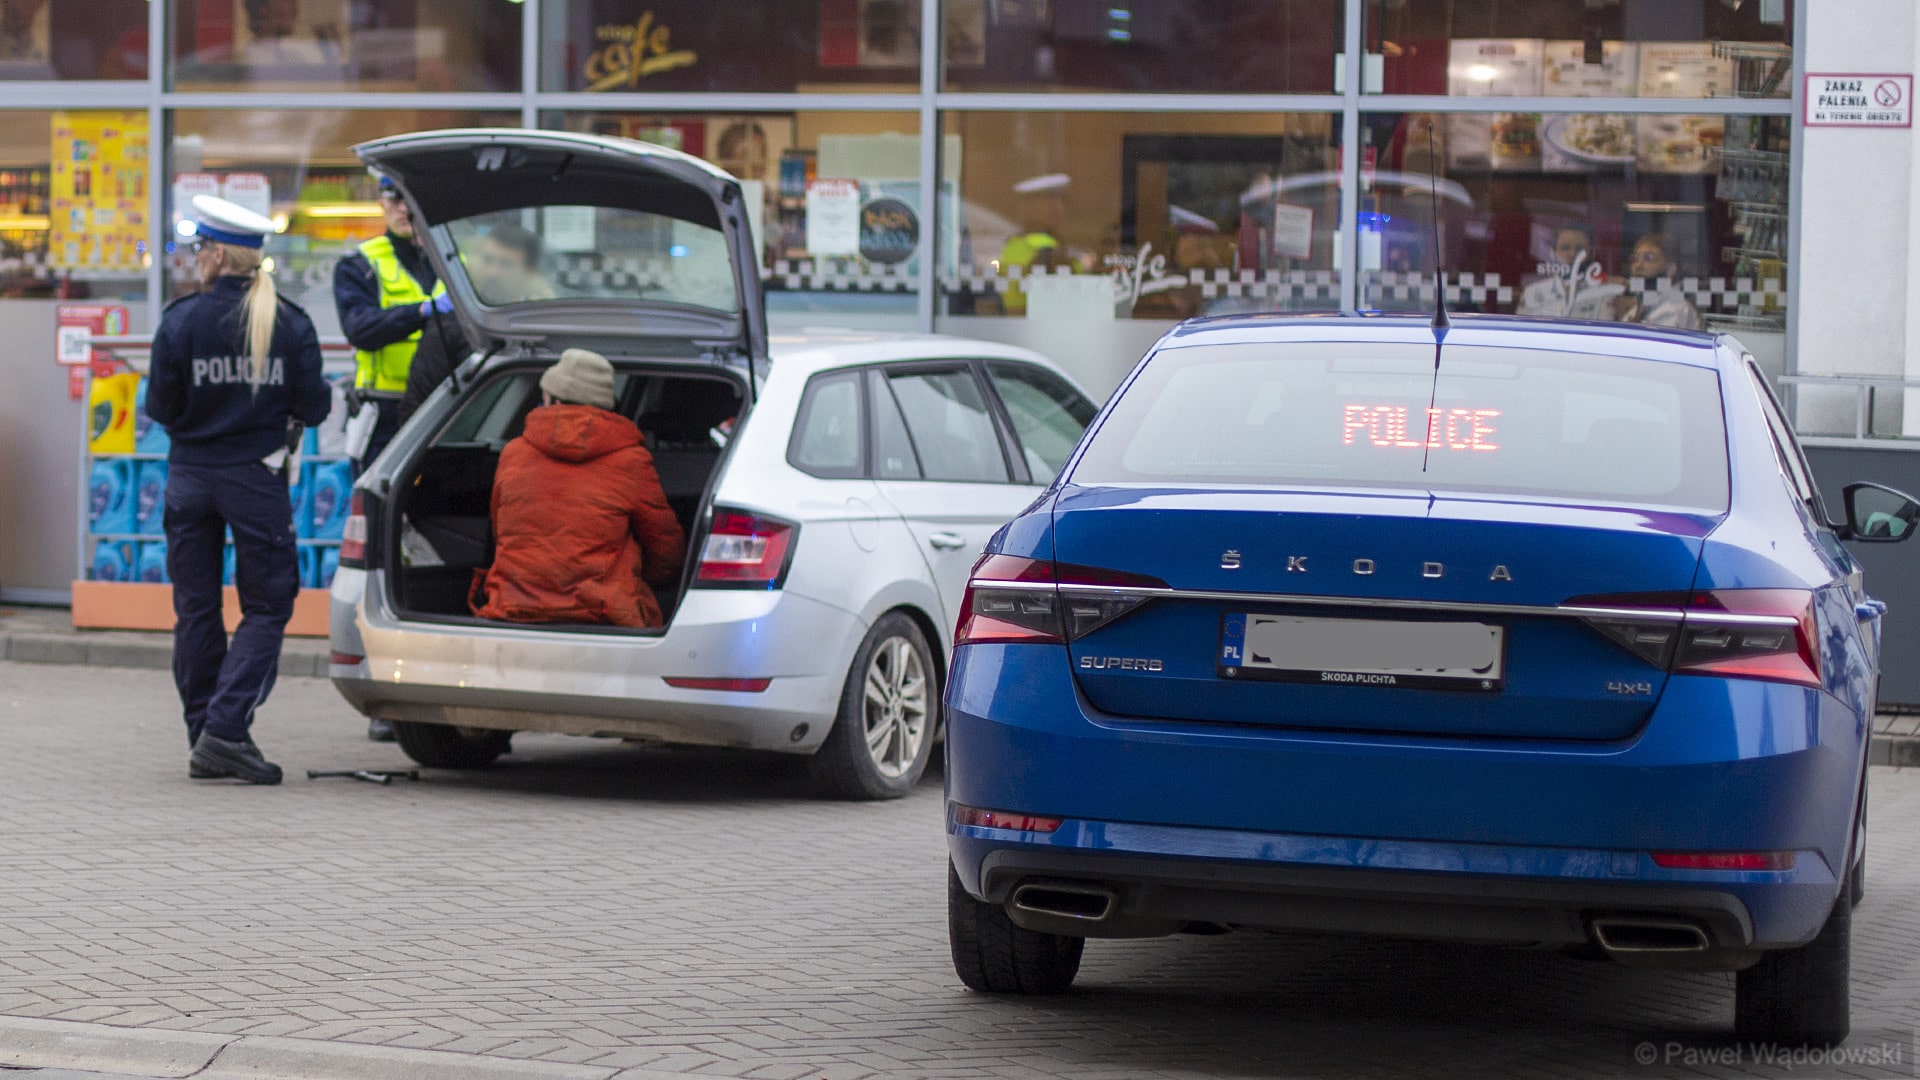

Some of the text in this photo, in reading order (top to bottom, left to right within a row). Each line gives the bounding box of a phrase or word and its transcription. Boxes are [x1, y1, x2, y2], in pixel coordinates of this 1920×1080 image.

[1824, 80, 1862, 92] ZAKAZ
[1818, 95, 1867, 107] PALENIA
[1536, 260, 1571, 276] stop
[192, 355, 284, 387] POLICJA
[1343, 404, 1502, 452] POLICE
[1223, 645, 1241, 659] PL
[1080, 656, 1163, 671] SUPERB
[1355, 674, 1397, 684] PLICHTA
[1607, 681, 1652, 696] 4x4
